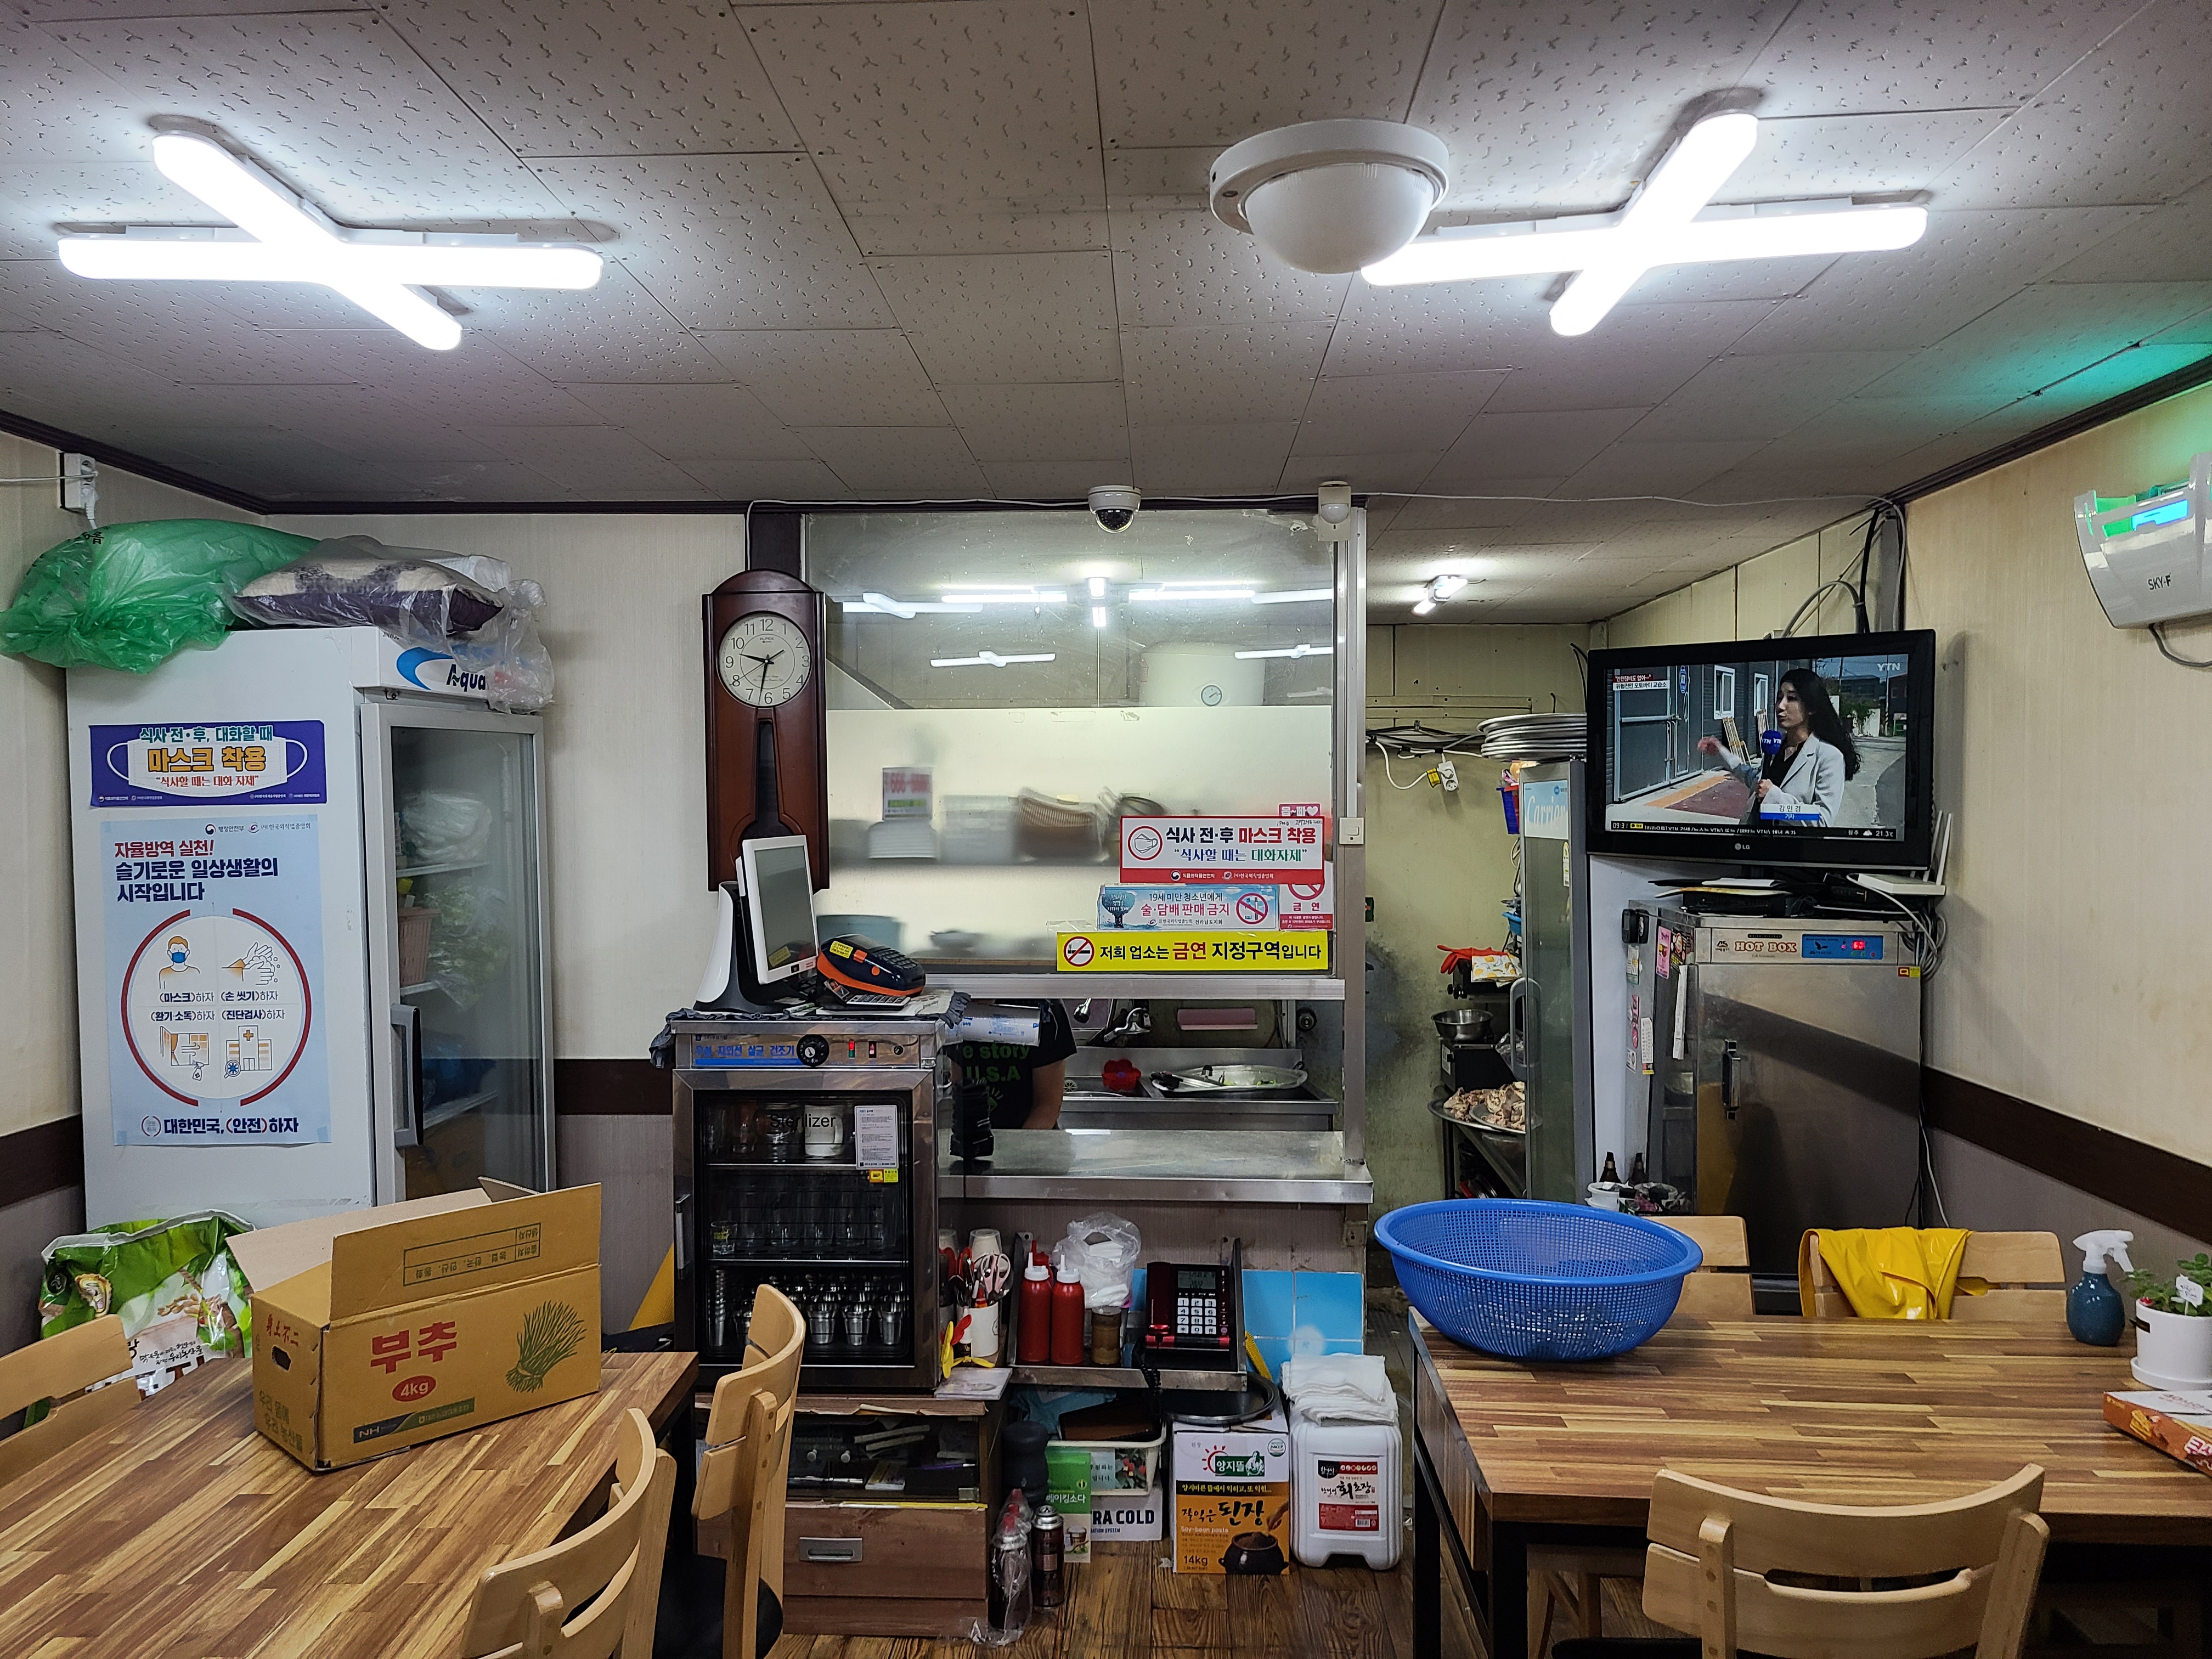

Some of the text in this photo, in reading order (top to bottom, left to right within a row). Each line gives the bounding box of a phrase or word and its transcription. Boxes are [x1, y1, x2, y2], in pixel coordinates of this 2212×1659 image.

[2148, 575, 2171, 590] SKY-F
[744, 623, 755, 635] 11
[760, 618, 774, 631] 12
[782, 623, 786, 635] 1
[731, 637, 744, 650] 10
[795, 636, 804, 648] 2
[725, 656, 733, 668] 9
[802, 655, 810, 667] 3
[1877, 663, 1900, 672] YTN
[446, 664, 486, 692] Aqua
[732, 675, 741, 687] 8
[796, 674, 804, 685] 4
[746, 689, 754, 700] 7
[764, 692, 773, 704] 6
[782, 688, 791, 699] 5
[140, 727, 166, 743] 식사
[216, 726, 255, 742] 대화할
[259, 725, 273, 741] 때
[148, 746, 266, 772] 마스크 착용
[191, 776, 210, 787] 때는
[213, 775, 233, 787] 대화
[1527, 795, 1566, 830] Carrier
[1166, 827, 1316, 844] 식사 전·후 마스크 착용
[114, 839, 215, 859] 자율방역 실천!
[1222, 849, 1246, 862] 때는
[116, 857, 278, 881] 슬기로운 일상생활의
[117, 882, 205, 902] 시작입니다
[1149, 892, 1222, 902] 19세 미만 청소년에게
[1141, 902, 1229, 917] 술·담배 판매 금지
[1293, 902, 1319, 911] 금 연
[1099, 941, 1322, 961] 저희 업소는 금연 지정구역입니다
[1735, 941, 1797, 952] HOT BOX
[159, 991, 278, 1003] (마스크)하자 (손 씻기)하자
[222, 1009, 285, 1020] (진단검사)하자
[718, 1045, 742, 1057] 자외선
[748, 1045, 764, 1057] 살균
[770, 1045, 795, 1057] 건조기
[980, 1043, 1030, 1059] story
[966, 1065, 1022, 1082] U.S.A
[164, 1119, 224, 1135] 대한민국,
[226, 1118, 299, 1134] (안전)하자
[770, 1113, 837, 1128] Sterilizer
[518, 1228, 538, 1240] 생산자
[266, 1314, 299, 1347] 身土不二
[370, 1321, 458, 1374] 부추
[400, 1382, 428, 1396] 4kg
[359, 1426, 380, 1438] NH
[1046, 1493, 1086, 1504] 베이킹소다
[1091, 1510, 1155, 1525] RA COLD
[1217, 1500, 1265, 1526] 된장
[1183, 1555, 1208, 1566] 14kg
